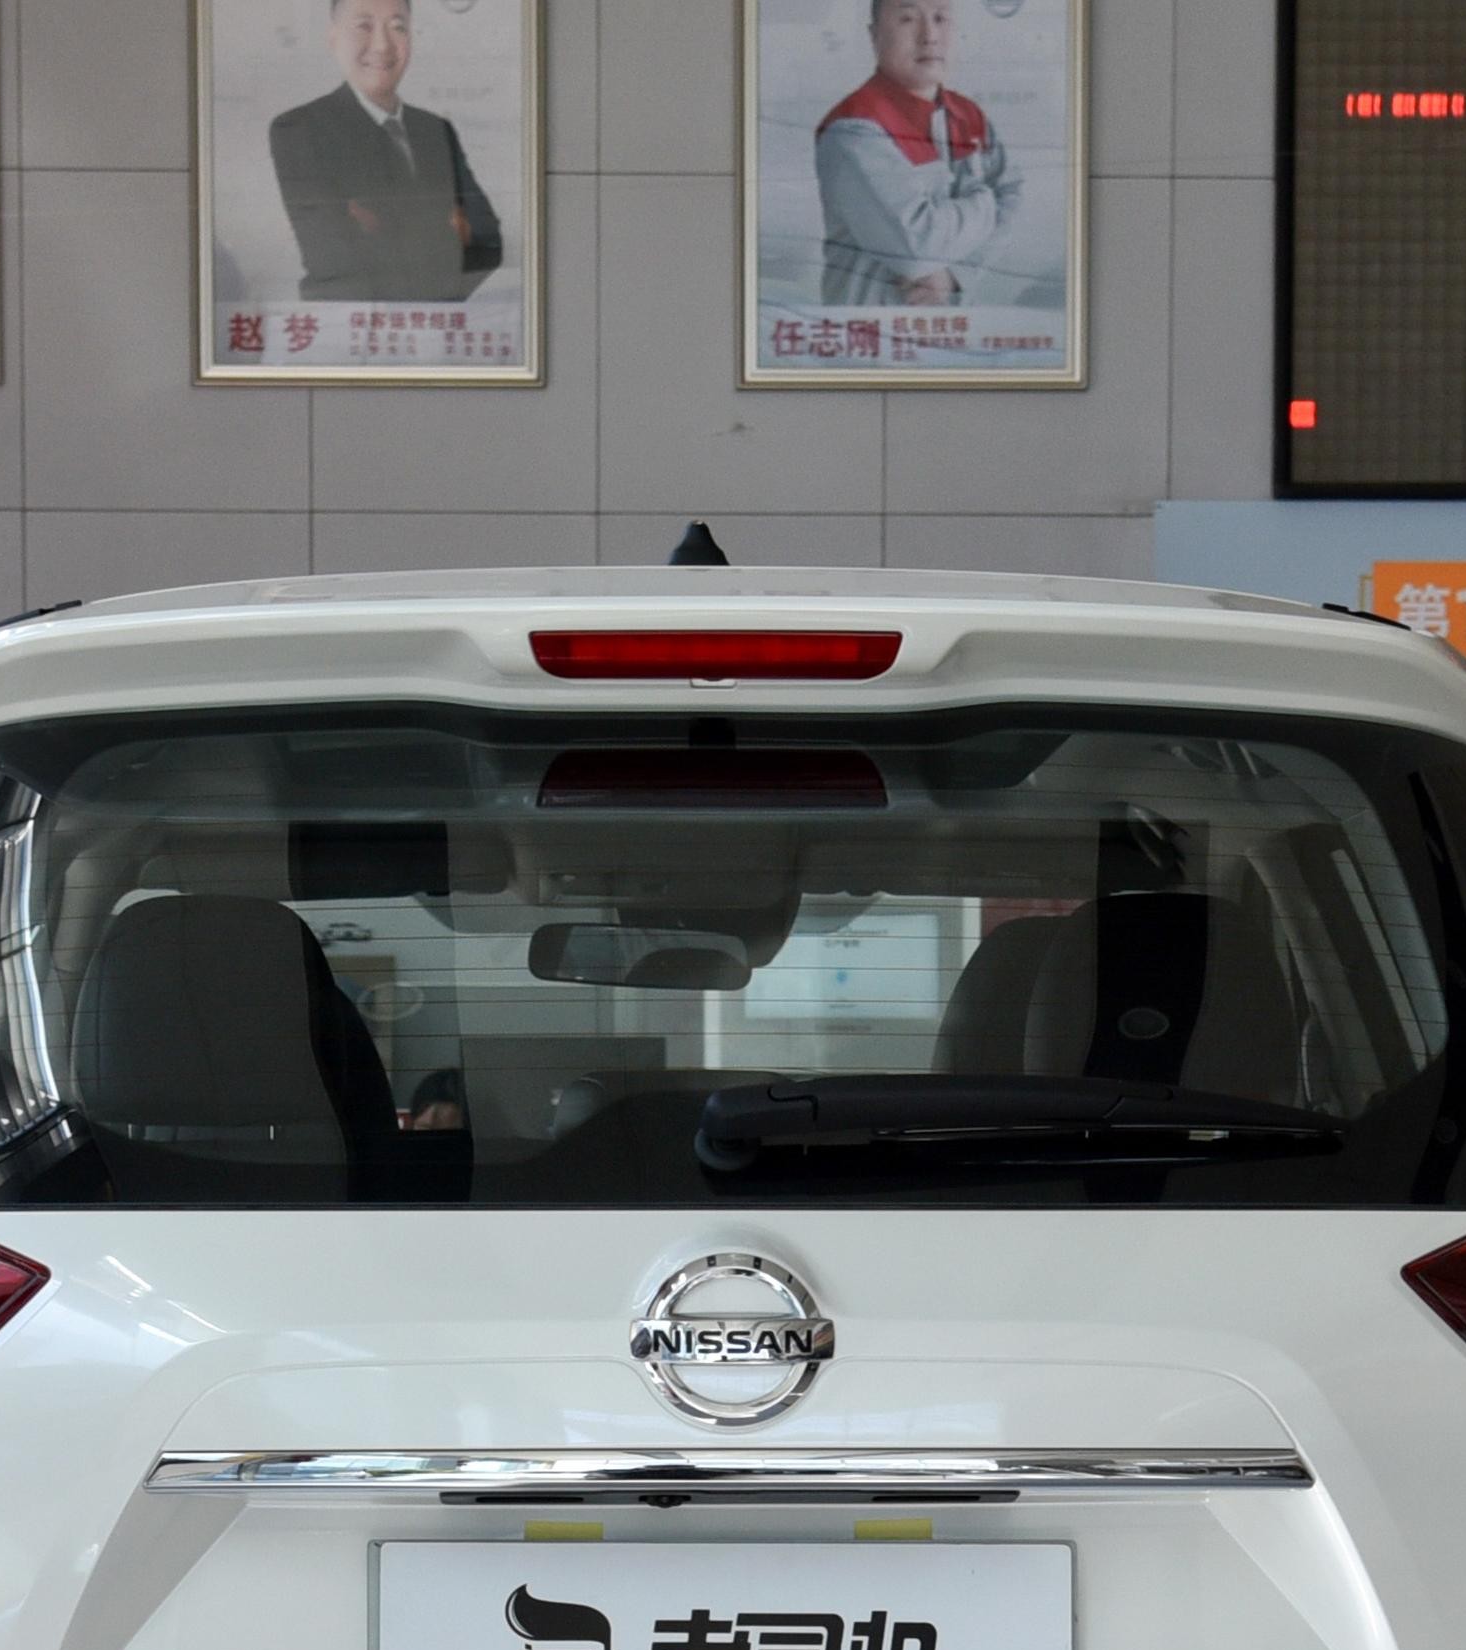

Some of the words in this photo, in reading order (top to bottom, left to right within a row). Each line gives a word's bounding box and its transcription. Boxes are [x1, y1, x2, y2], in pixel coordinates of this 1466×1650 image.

[772, 318, 881, 358] 任志刚
[652, 1327, 815, 1357] NISSAN
